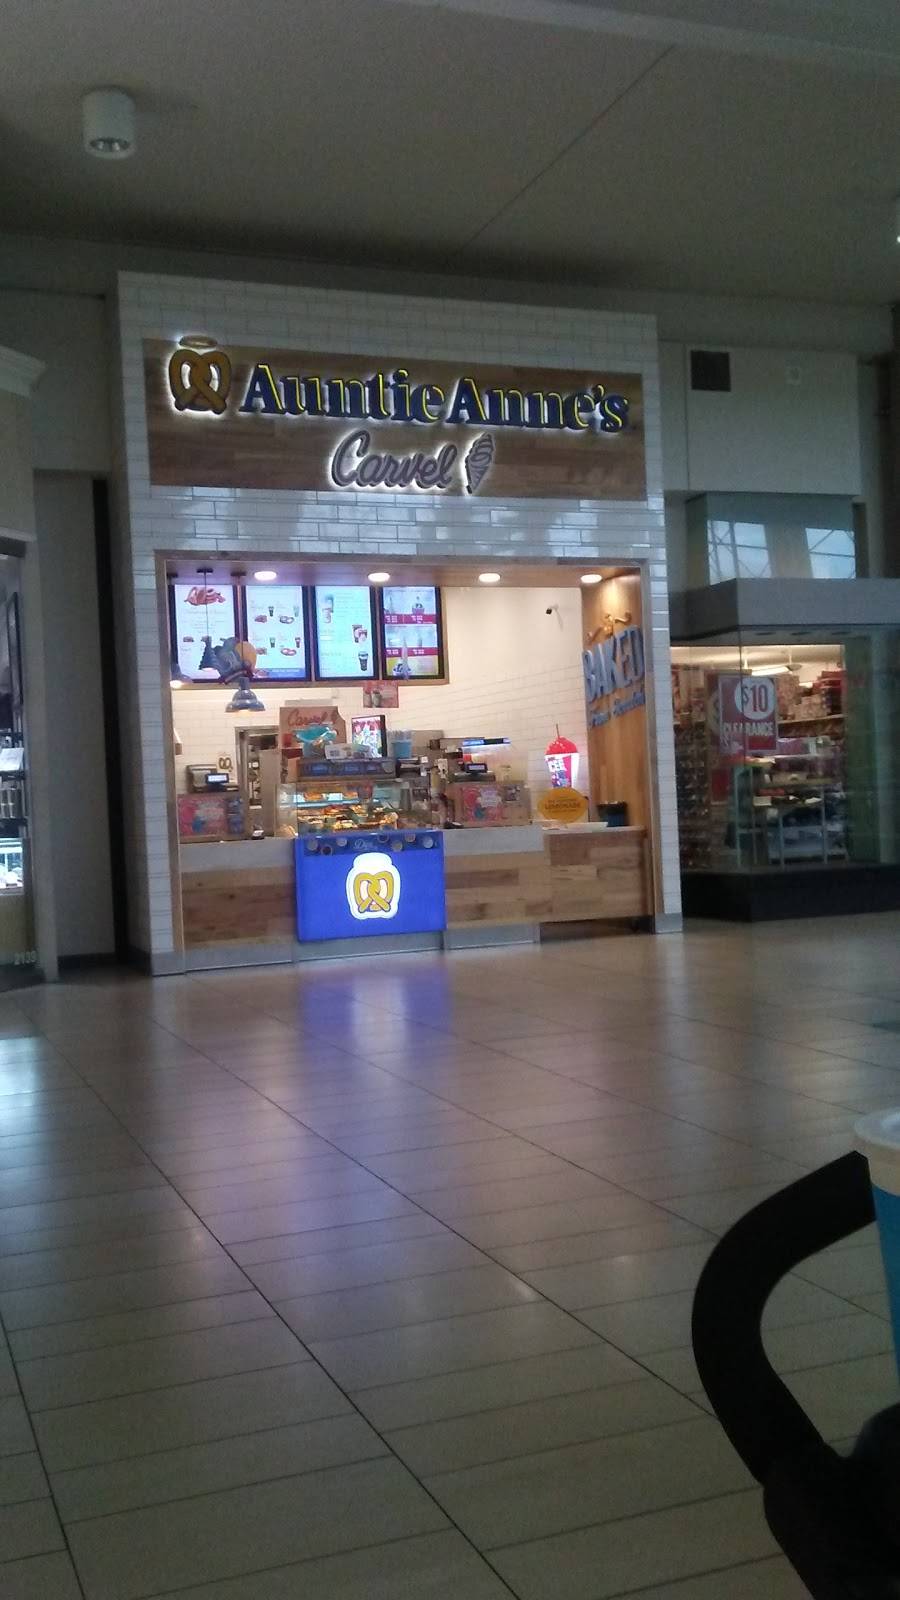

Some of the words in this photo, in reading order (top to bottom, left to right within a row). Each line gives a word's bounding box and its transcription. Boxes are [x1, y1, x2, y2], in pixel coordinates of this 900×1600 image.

[239, 363, 444, 424] Auntie
[447, 377, 628, 434] Anne's
[330, 430, 455, 490] Carvel
[582, 625, 645, 702] BAKED
[741, 685, 768, 713] $10
[723, 722, 774, 737] CLEARANCE
